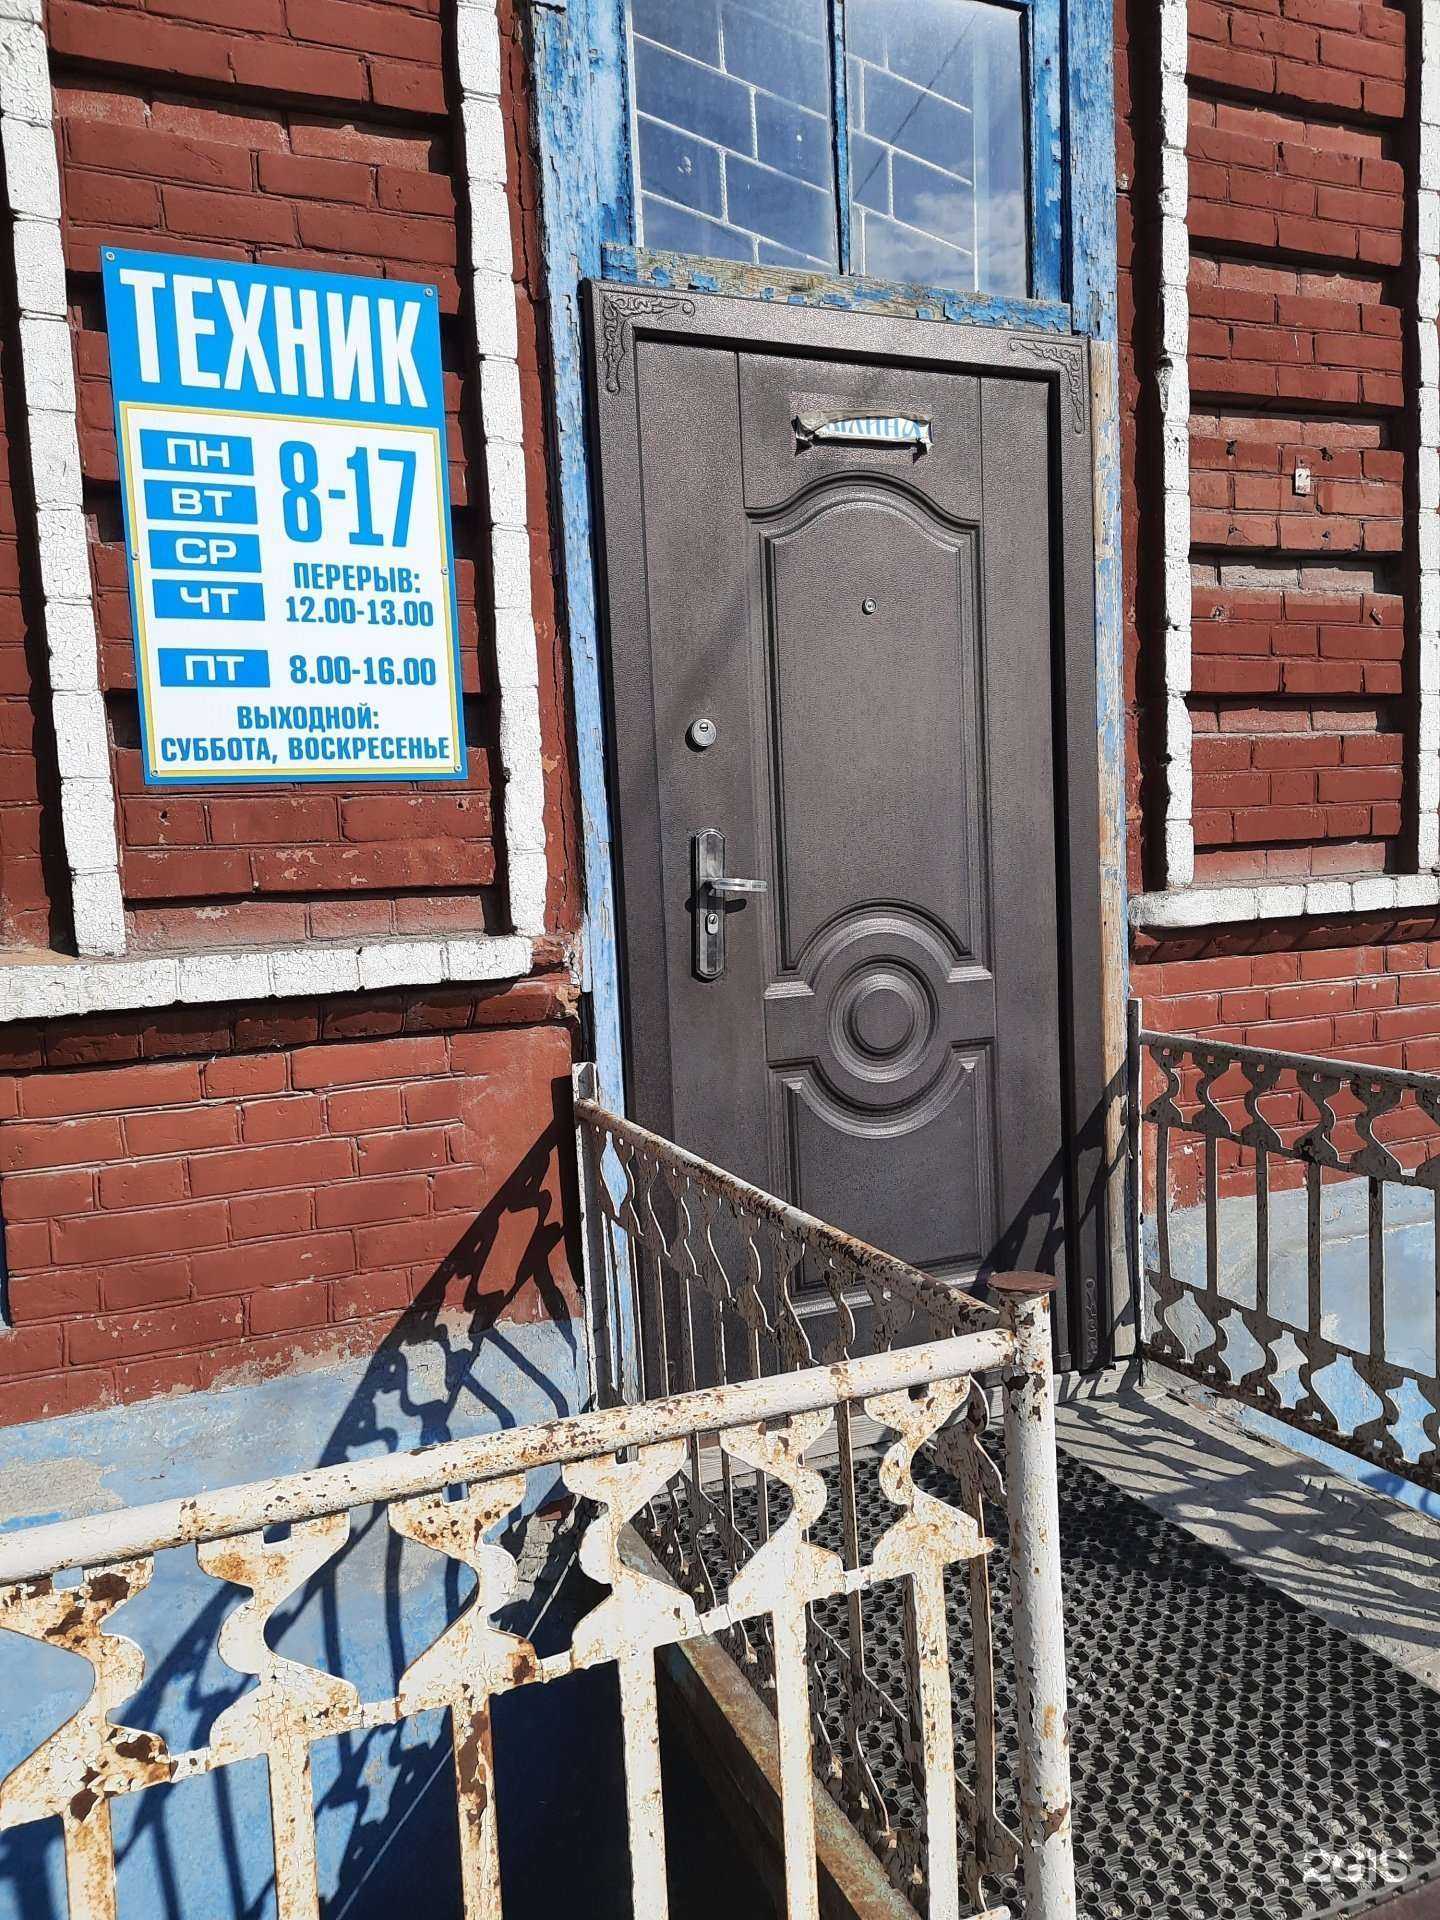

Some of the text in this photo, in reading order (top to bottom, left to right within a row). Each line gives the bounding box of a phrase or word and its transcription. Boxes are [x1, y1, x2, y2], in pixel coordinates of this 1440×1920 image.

[119, 268, 428, 408] ТЕХНИК
[167, 439, 230, 468] ПН
[172, 489, 232, 517] ВТ
[279, 441, 416, 547] 8-17
[176, 538, 237, 565] СР
[293, 563, 420, 594] ПЕРЕРЫВ:
[180, 587, 239, 614] ЧТ
[286, 596, 434, 627] 12.00-13.00
[185, 655, 245, 681] ПТ
[290, 655, 437, 686] 8.00-16.00
[237, 702, 380, 732] ВЫХОДНОЙ:
[161, 737, 450, 765] СУББОТА, ВОСКРЕСЕНЬЕ
